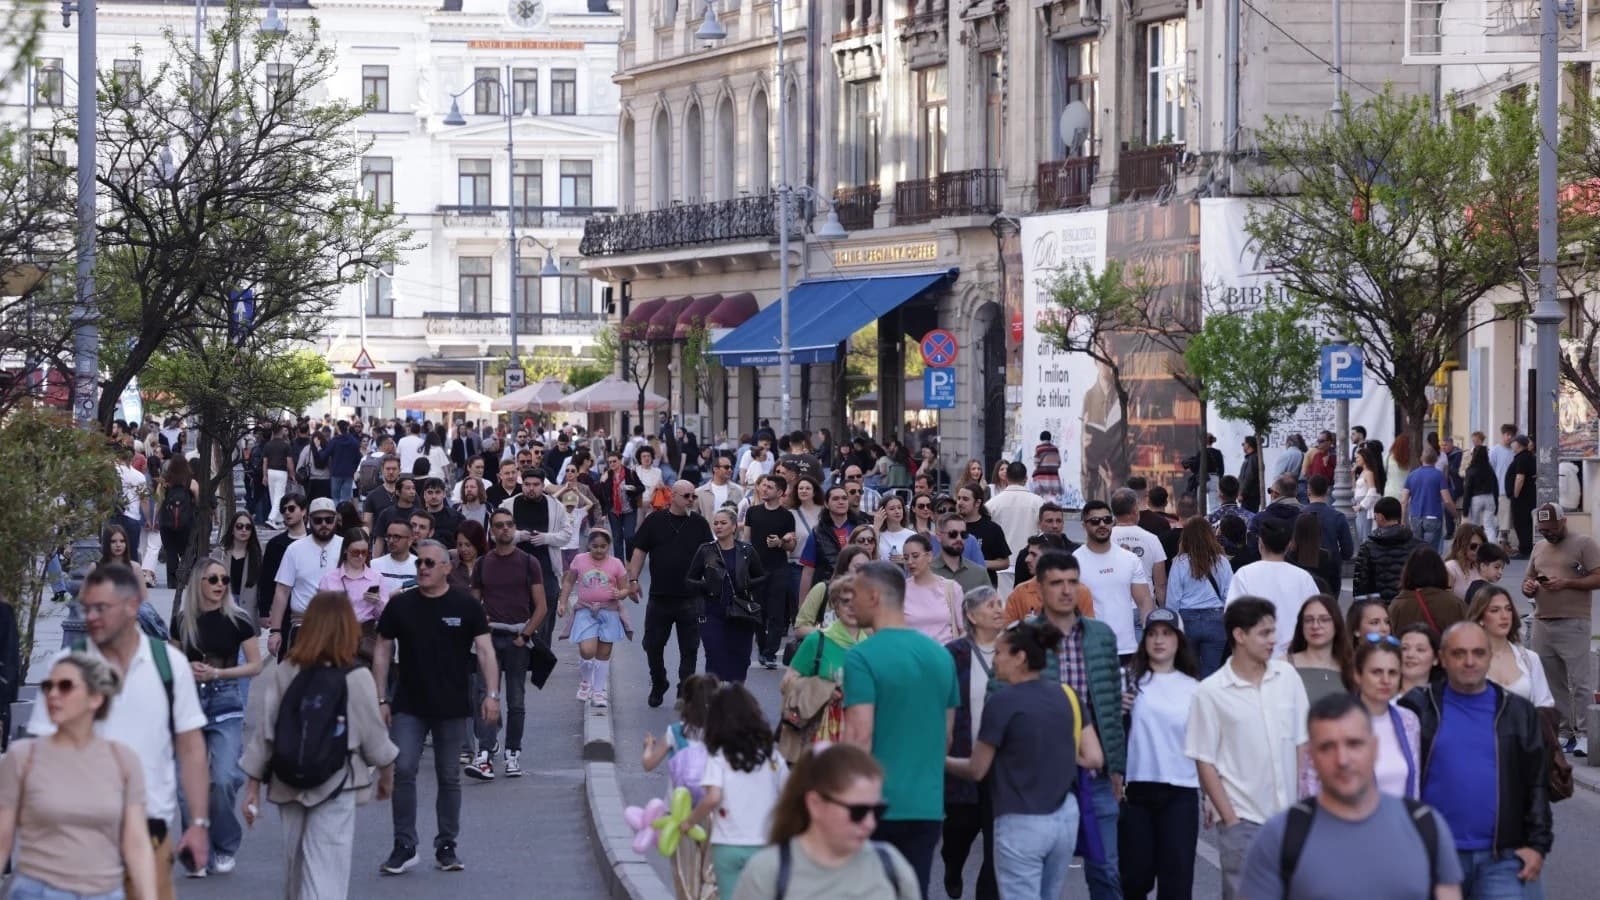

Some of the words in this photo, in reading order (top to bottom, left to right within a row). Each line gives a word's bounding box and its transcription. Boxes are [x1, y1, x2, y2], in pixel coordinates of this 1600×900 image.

[907, 242, 936, 259] COFFEE
[1045, 363, 1069, 384] milion
[1330, 351, 1352, 382] P
[931, 371, 949, 397] P
[1037, 389, 1046, 408] de
[1049, 388, 1071, 408] titluri
